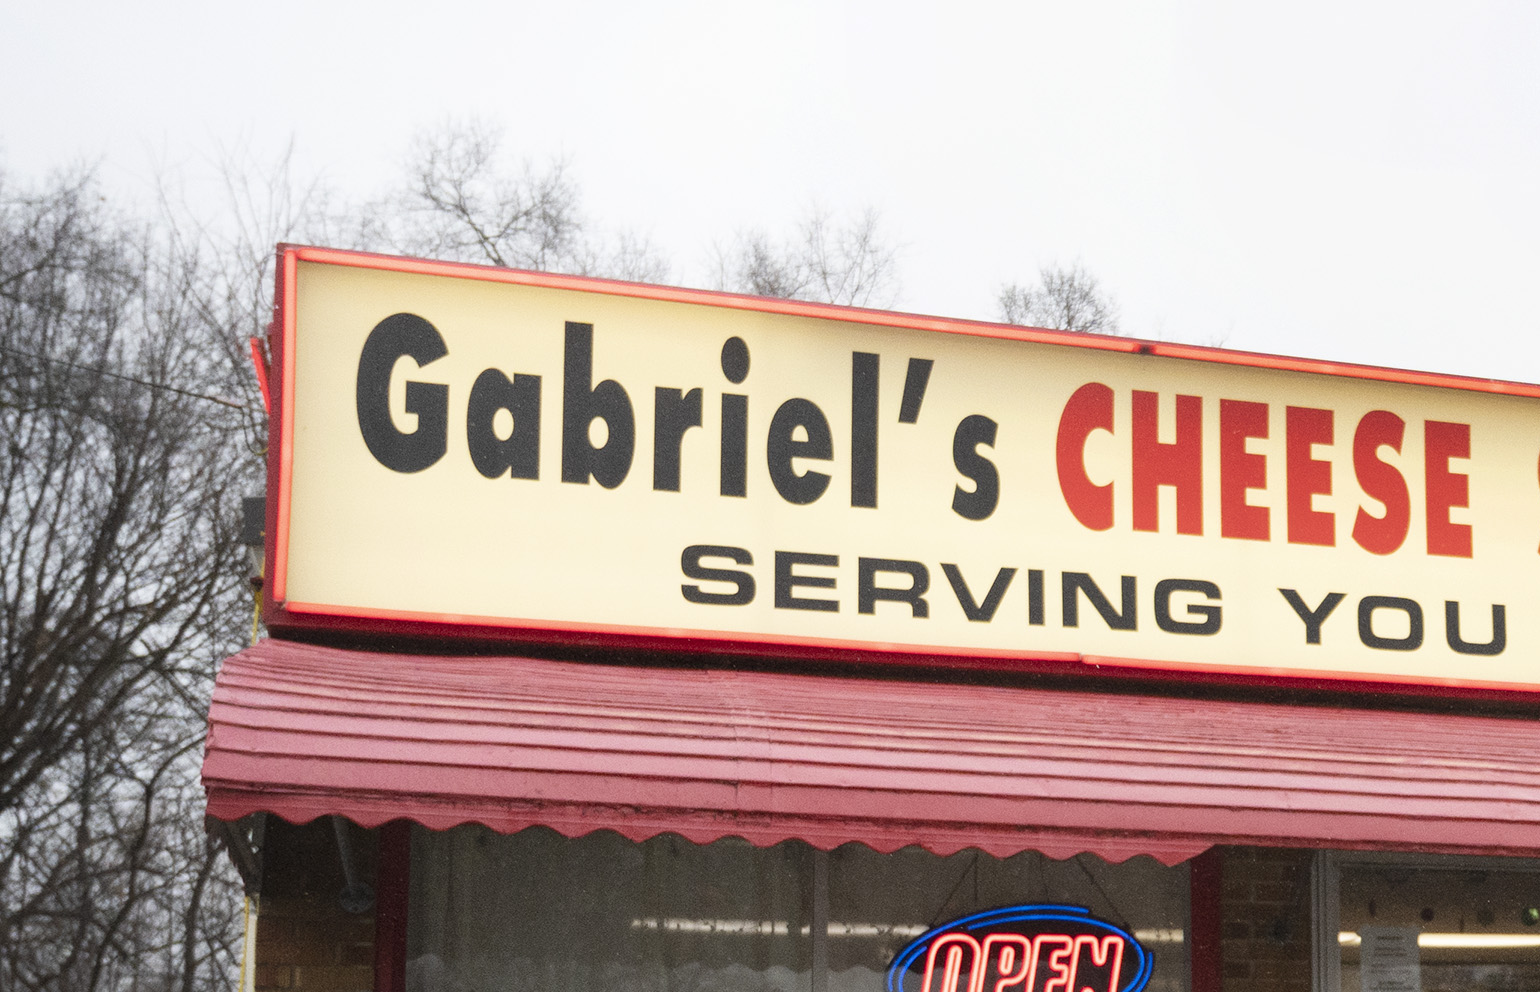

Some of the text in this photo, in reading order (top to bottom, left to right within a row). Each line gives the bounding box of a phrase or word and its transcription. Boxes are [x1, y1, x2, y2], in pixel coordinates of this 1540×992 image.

[356, 312, 998, 521] Gabriel's
[1057, 382, 1473, 558] CHEESE
[681, 544, 1222, 636] SERVING
[1279, 588, 1507, 656] YOU
